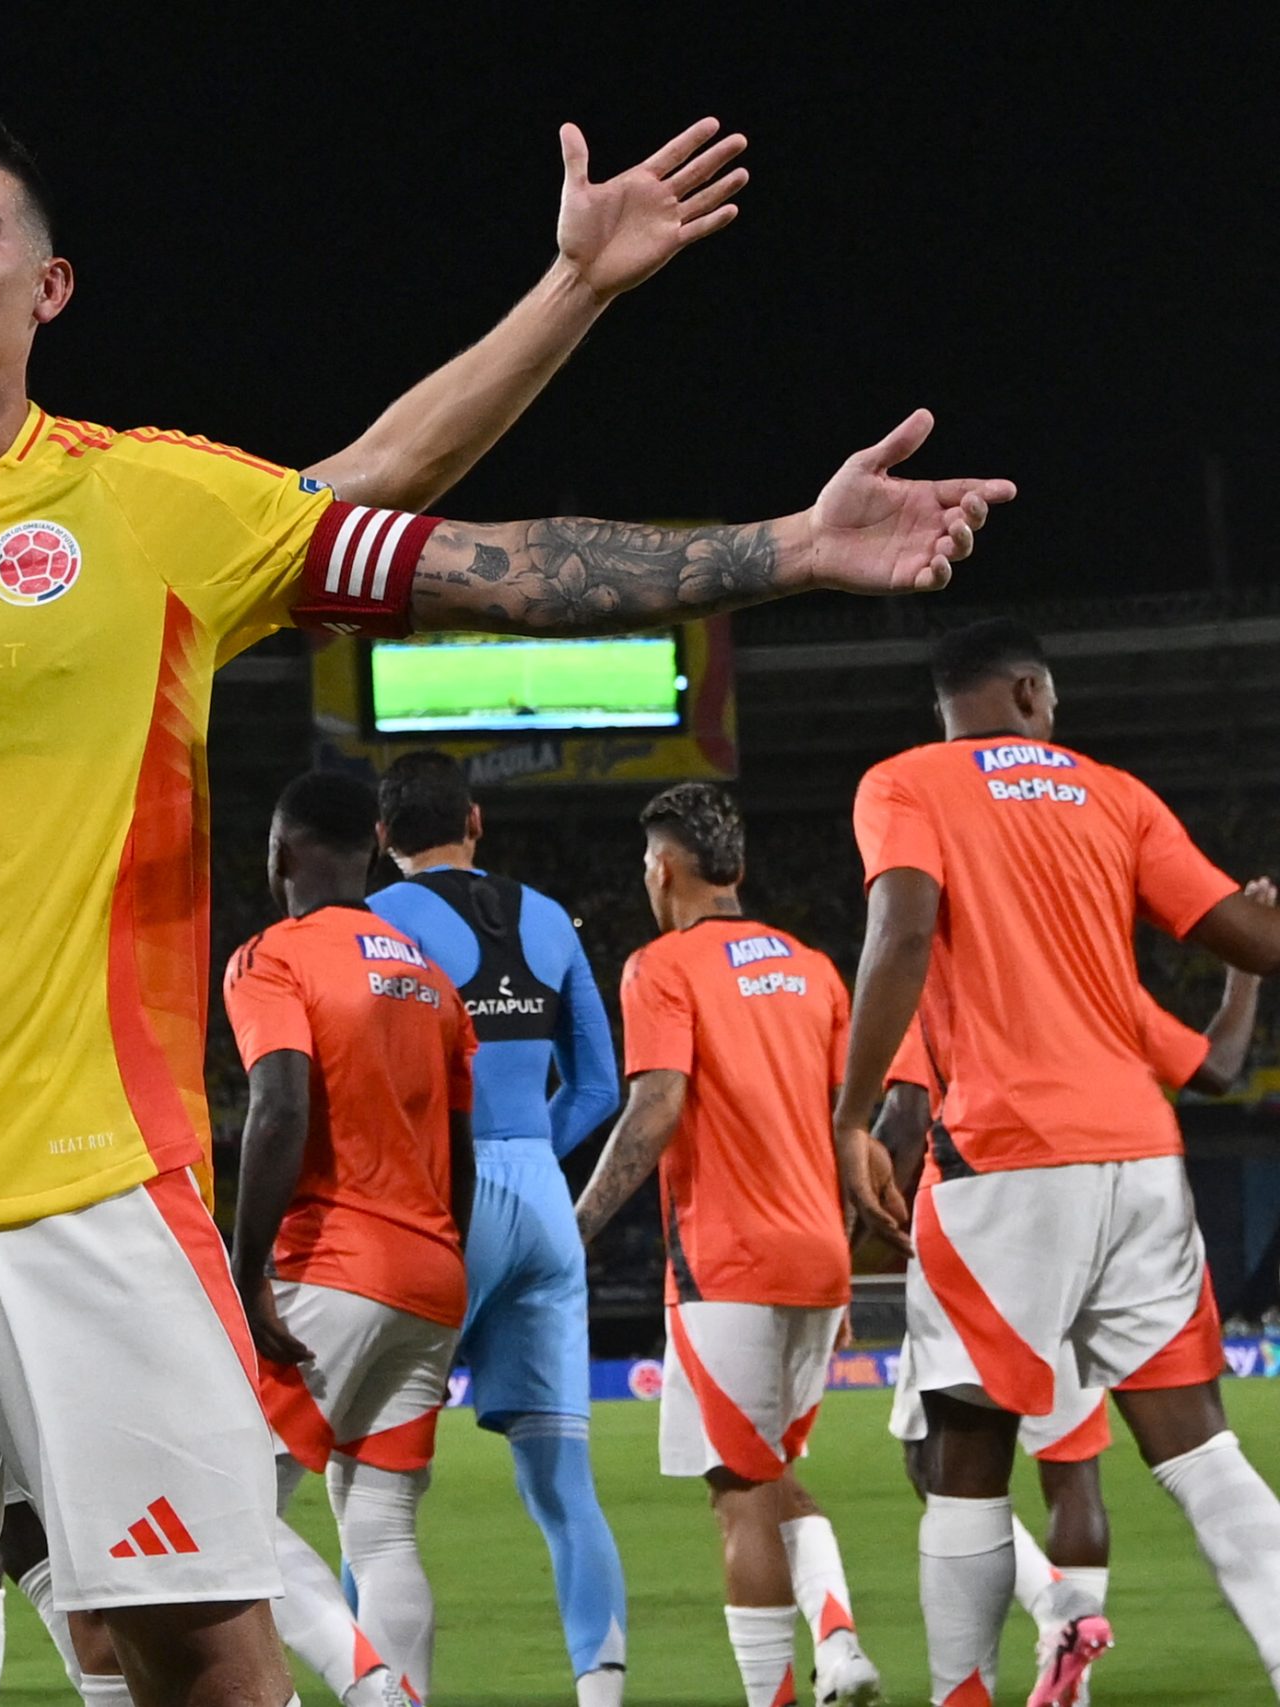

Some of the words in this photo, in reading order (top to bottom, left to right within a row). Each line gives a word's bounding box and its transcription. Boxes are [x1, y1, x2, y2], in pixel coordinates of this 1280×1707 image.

[982, 745, 1073, 773] AGUILA
[987, 777, 1087, 806] BetPlay
[361, 934, 429, 970] AGUILA
[728, 935, 792, 968] AGUILA
[367, 971, 440, 1010] BetPlay
[737, 971, 807, 997] BetPlay
[463, 997, 545, 1017] CATAPULT
